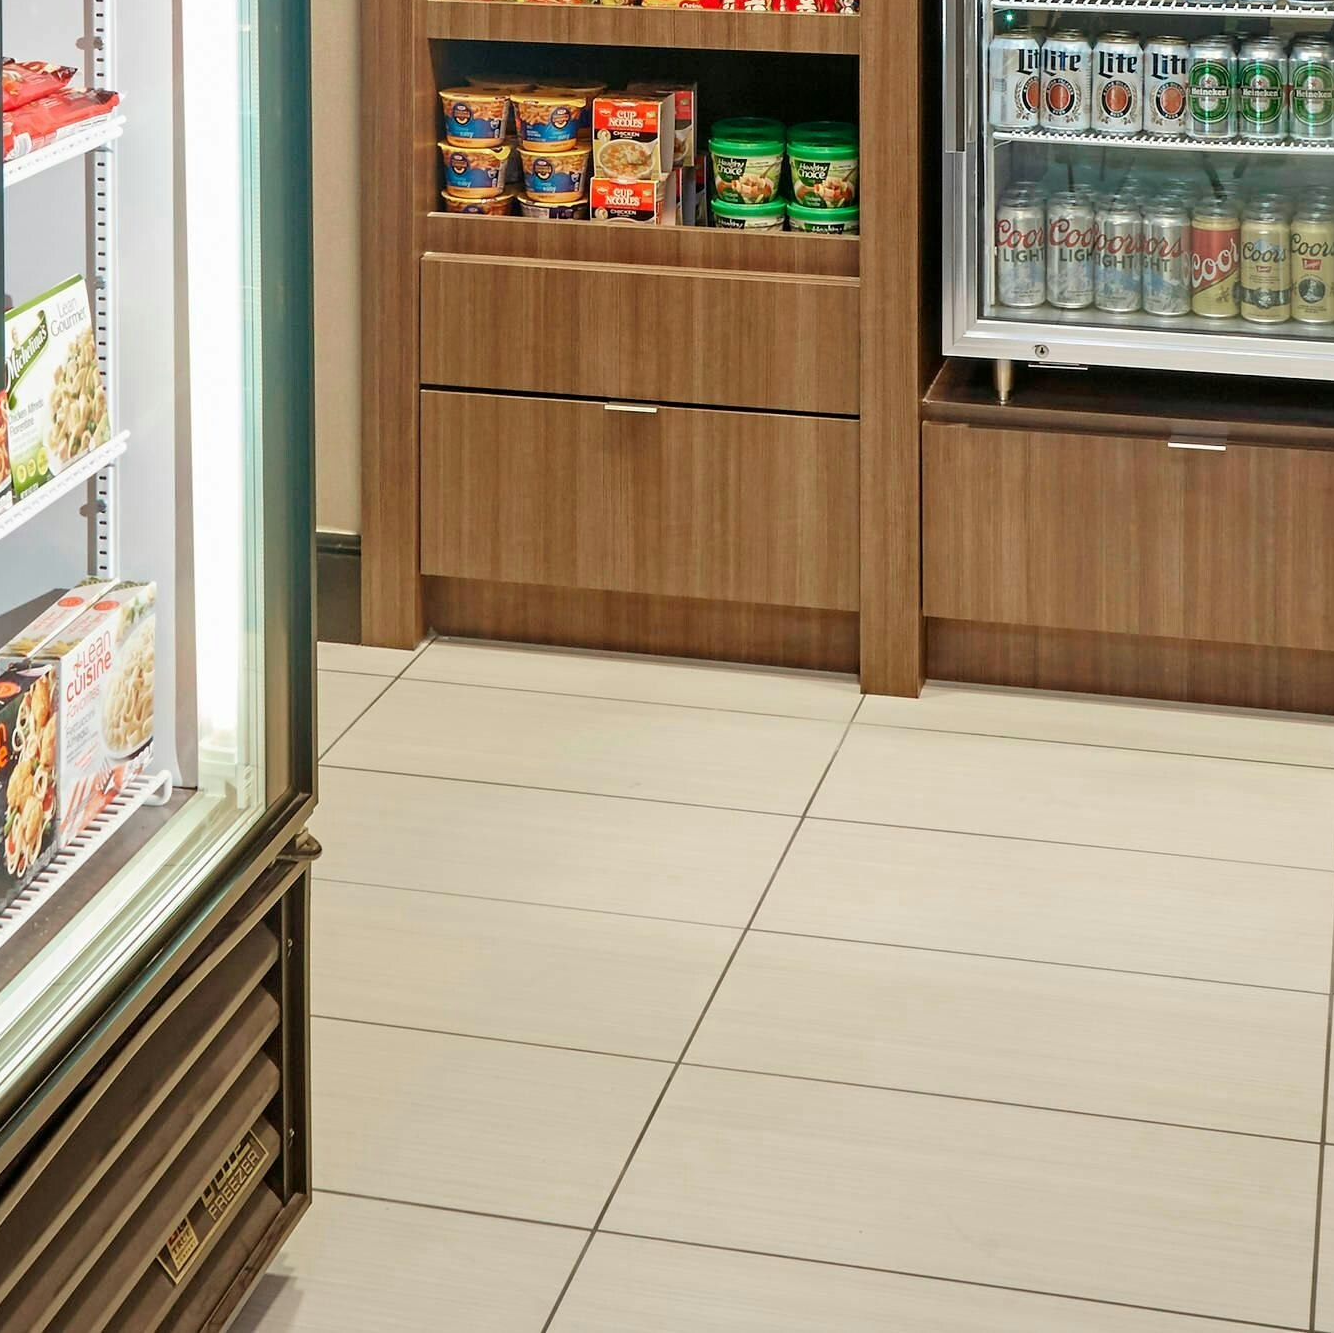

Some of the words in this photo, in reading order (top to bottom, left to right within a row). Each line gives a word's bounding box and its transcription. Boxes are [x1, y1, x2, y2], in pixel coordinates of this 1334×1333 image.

[1043, 48, 1083, 77] Lite
[1098, 50, 1139, 79] Lite
[1190, 87, 1228, 97] Heineken
[1241, 88, 1279, 97] Heineken
[1295, 89, 1333, 98] Heineken
[616, 111, 637, 121] CUP
[608, 118, 644, 129] NOODLES
[612, 130, 641, 138] CHICKEN
[717, 165, 744, 177] Choice
[798, 169, 827, 181] Choice
[612, 189, 634, 199] CUP
[604, 196, 641, 207] NOODLES
[609, 209, 637, 217] CHICKEN
[1241, 241, 1287, 264] Coors
[83, 629, 111, 669] Lean
[208, 1150, 260, 1221] FREEZER
